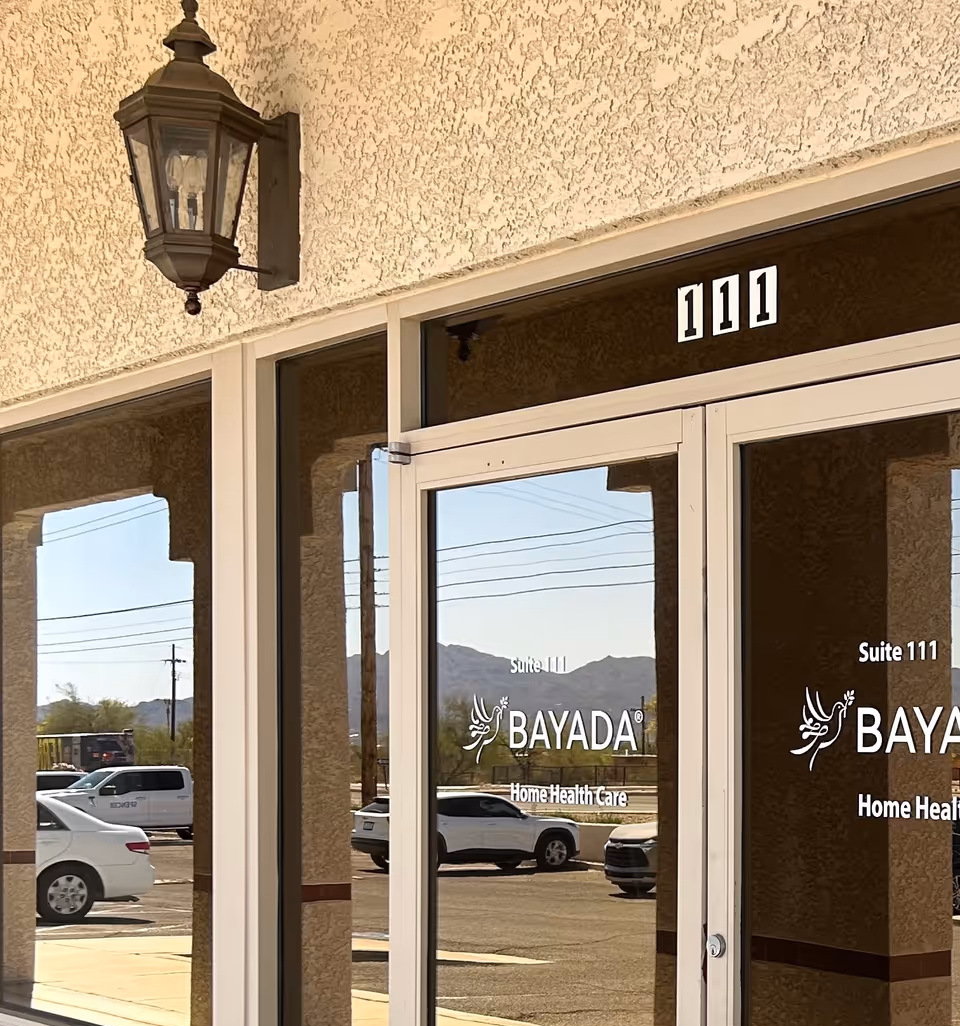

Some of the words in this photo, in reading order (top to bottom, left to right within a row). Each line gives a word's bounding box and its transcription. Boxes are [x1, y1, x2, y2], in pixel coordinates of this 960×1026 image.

[685, 271, 770, 338] 111
[858, 641, 903, 662] Suite
[907, 640, 938, 660] 111
[510, 656, 542, 674] Suite
[545, 656, 566, 673] 111
[510, 782, 548, 803] Home
[550, 784, 593, 806] Health
[596, 786, 628, 807] Care
[857, 794, 911, 819] Home
